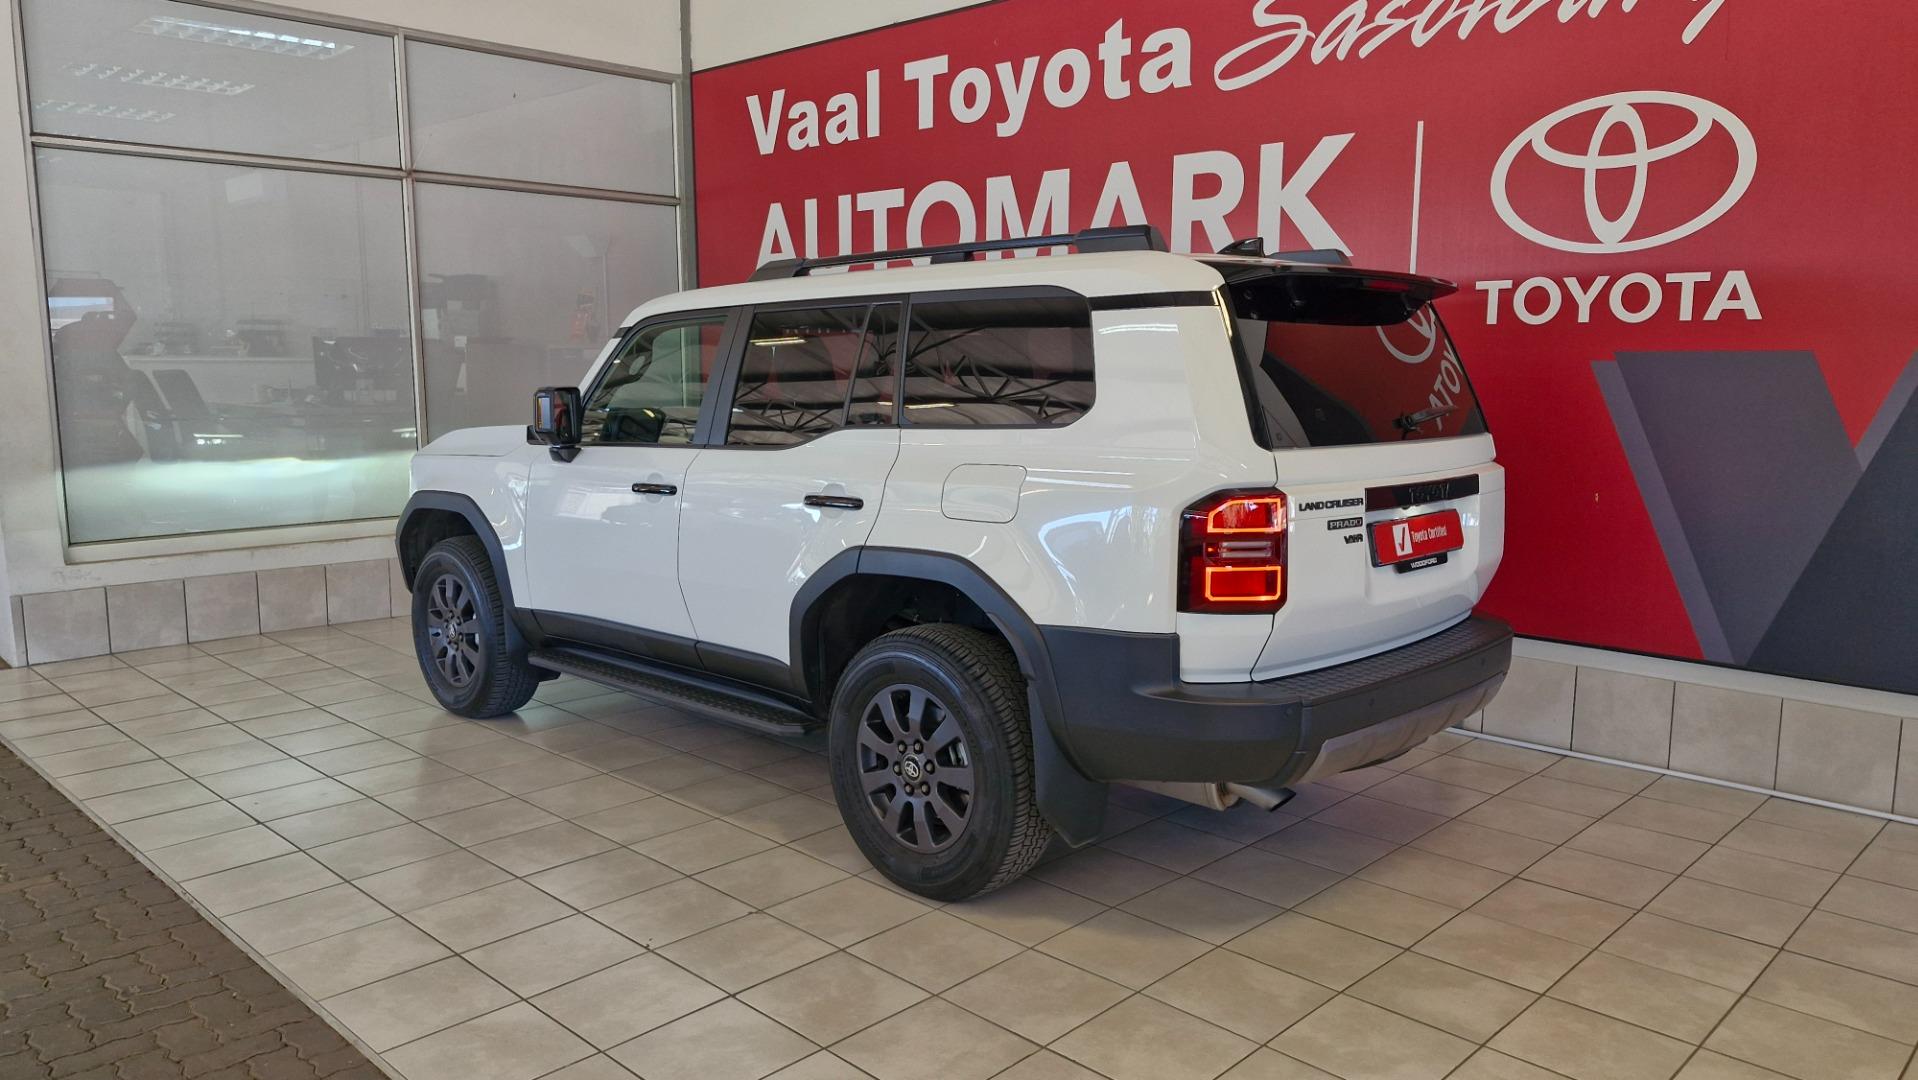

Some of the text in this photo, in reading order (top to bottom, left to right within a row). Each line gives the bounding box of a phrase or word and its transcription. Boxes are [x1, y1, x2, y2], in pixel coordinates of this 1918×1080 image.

[746, 70, 880, 155] Vaal
[904, 18, 1192, 137] Toyota
[756, 133, 1355, 276] AUTOMARK
[1476, 270, 1762, 325] TOYOTA
[1299, 498, 1363, 512] LAND CRUISER
[1329, 518, 1362, 530] PRADO
[1411, 529, 1428, 543] Toyota
